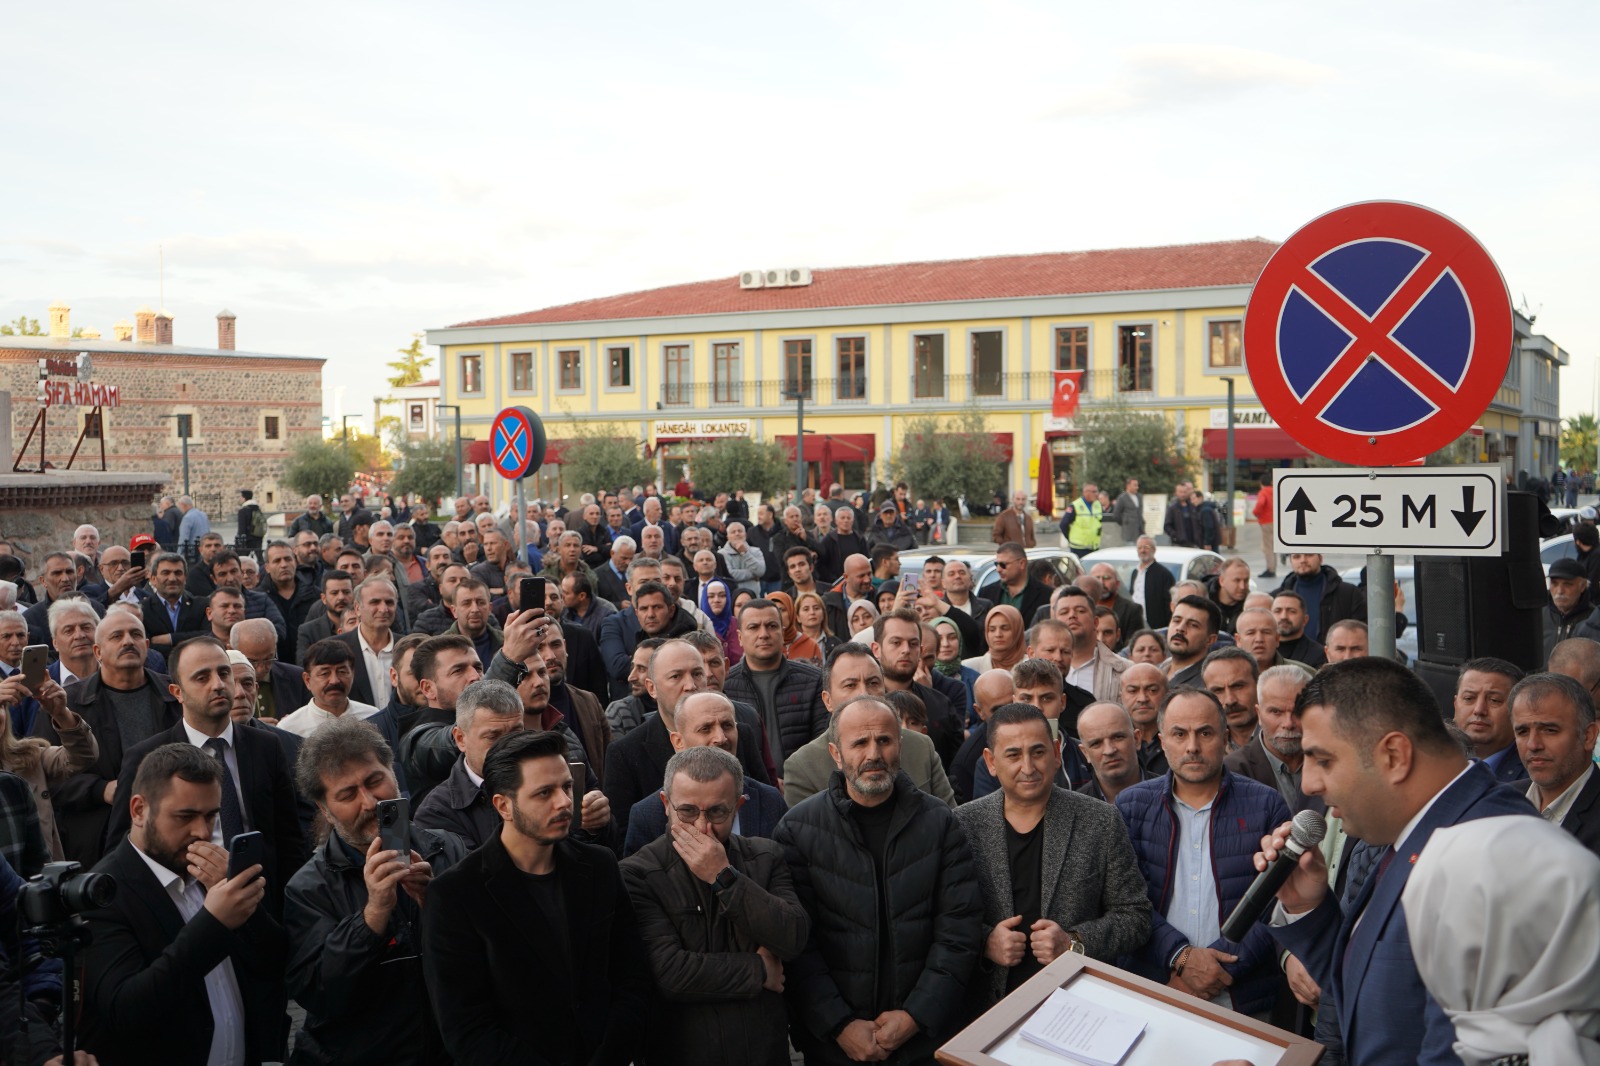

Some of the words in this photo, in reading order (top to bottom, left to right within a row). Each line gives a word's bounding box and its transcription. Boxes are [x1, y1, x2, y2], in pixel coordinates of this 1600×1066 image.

[74, 382, 120, 408] HAMAMI
[702, 422, 747, 434] LOKANTASI
[1331, 494, 1384, 528] 25
[1402, 494, 1436, 528] M
